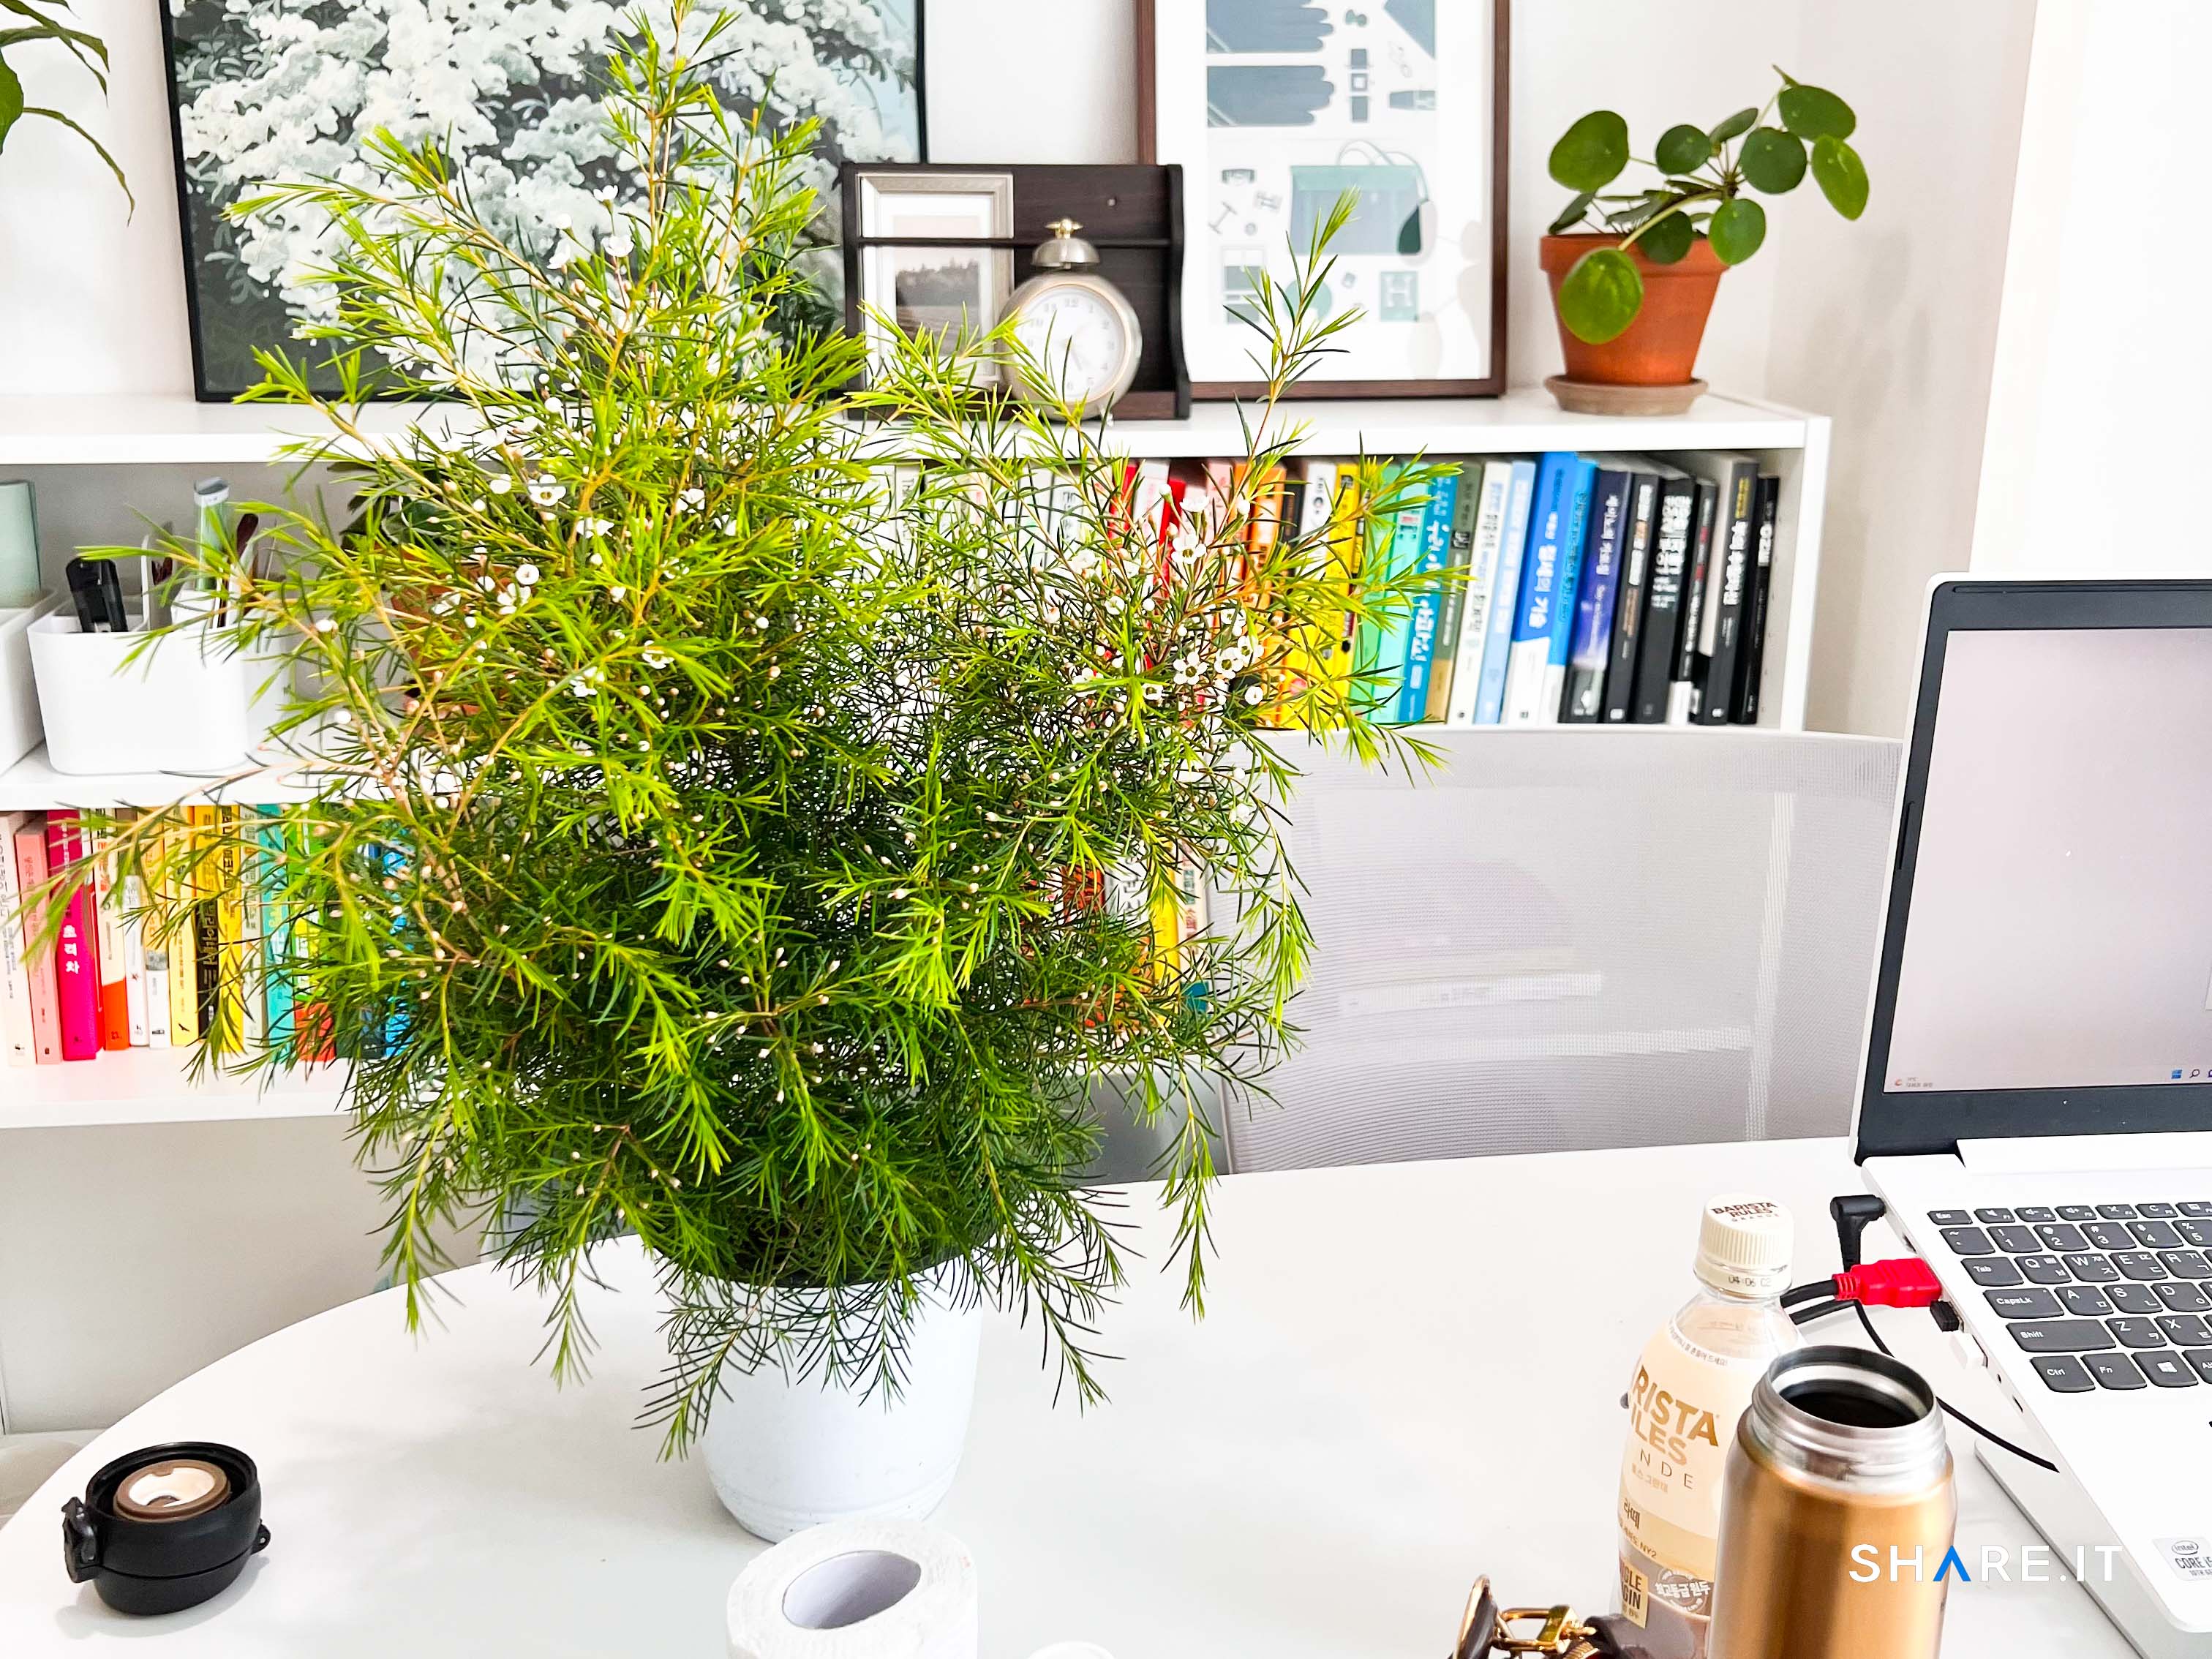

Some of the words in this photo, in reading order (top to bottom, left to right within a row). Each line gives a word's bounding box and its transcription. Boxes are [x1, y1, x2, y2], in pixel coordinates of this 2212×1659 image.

[1527, 596, 1549, 629] 기술
[1712, 1202, 1778, 1215] BARISTA
[1729, 1208, 1773, 1218] RULES
[2051, 1237, 2064, 1246] 2
[2098, 1235, 2110, 1244] 3
[2146, 1233, 2156, 1243] 4
[2192, 1232, 2203, 1241] 5
[2025, 1258, 2041, 1268] Q
[2071, 1256, 2089, 1266] W
[2118, 1254, 2134, 1265] E
[2165, 1253, 2182, 1263] R
[2066, 1290, 2080, 1300] A
[2113, 1287, 2128, 1298] S
[2160, 1285, 2175, 1295] D
[2115, 1321, 2132, 1331] Z
[2164, 1319, 2182, 1329] X
[2175, 1557, 2205, 1569] CORE
